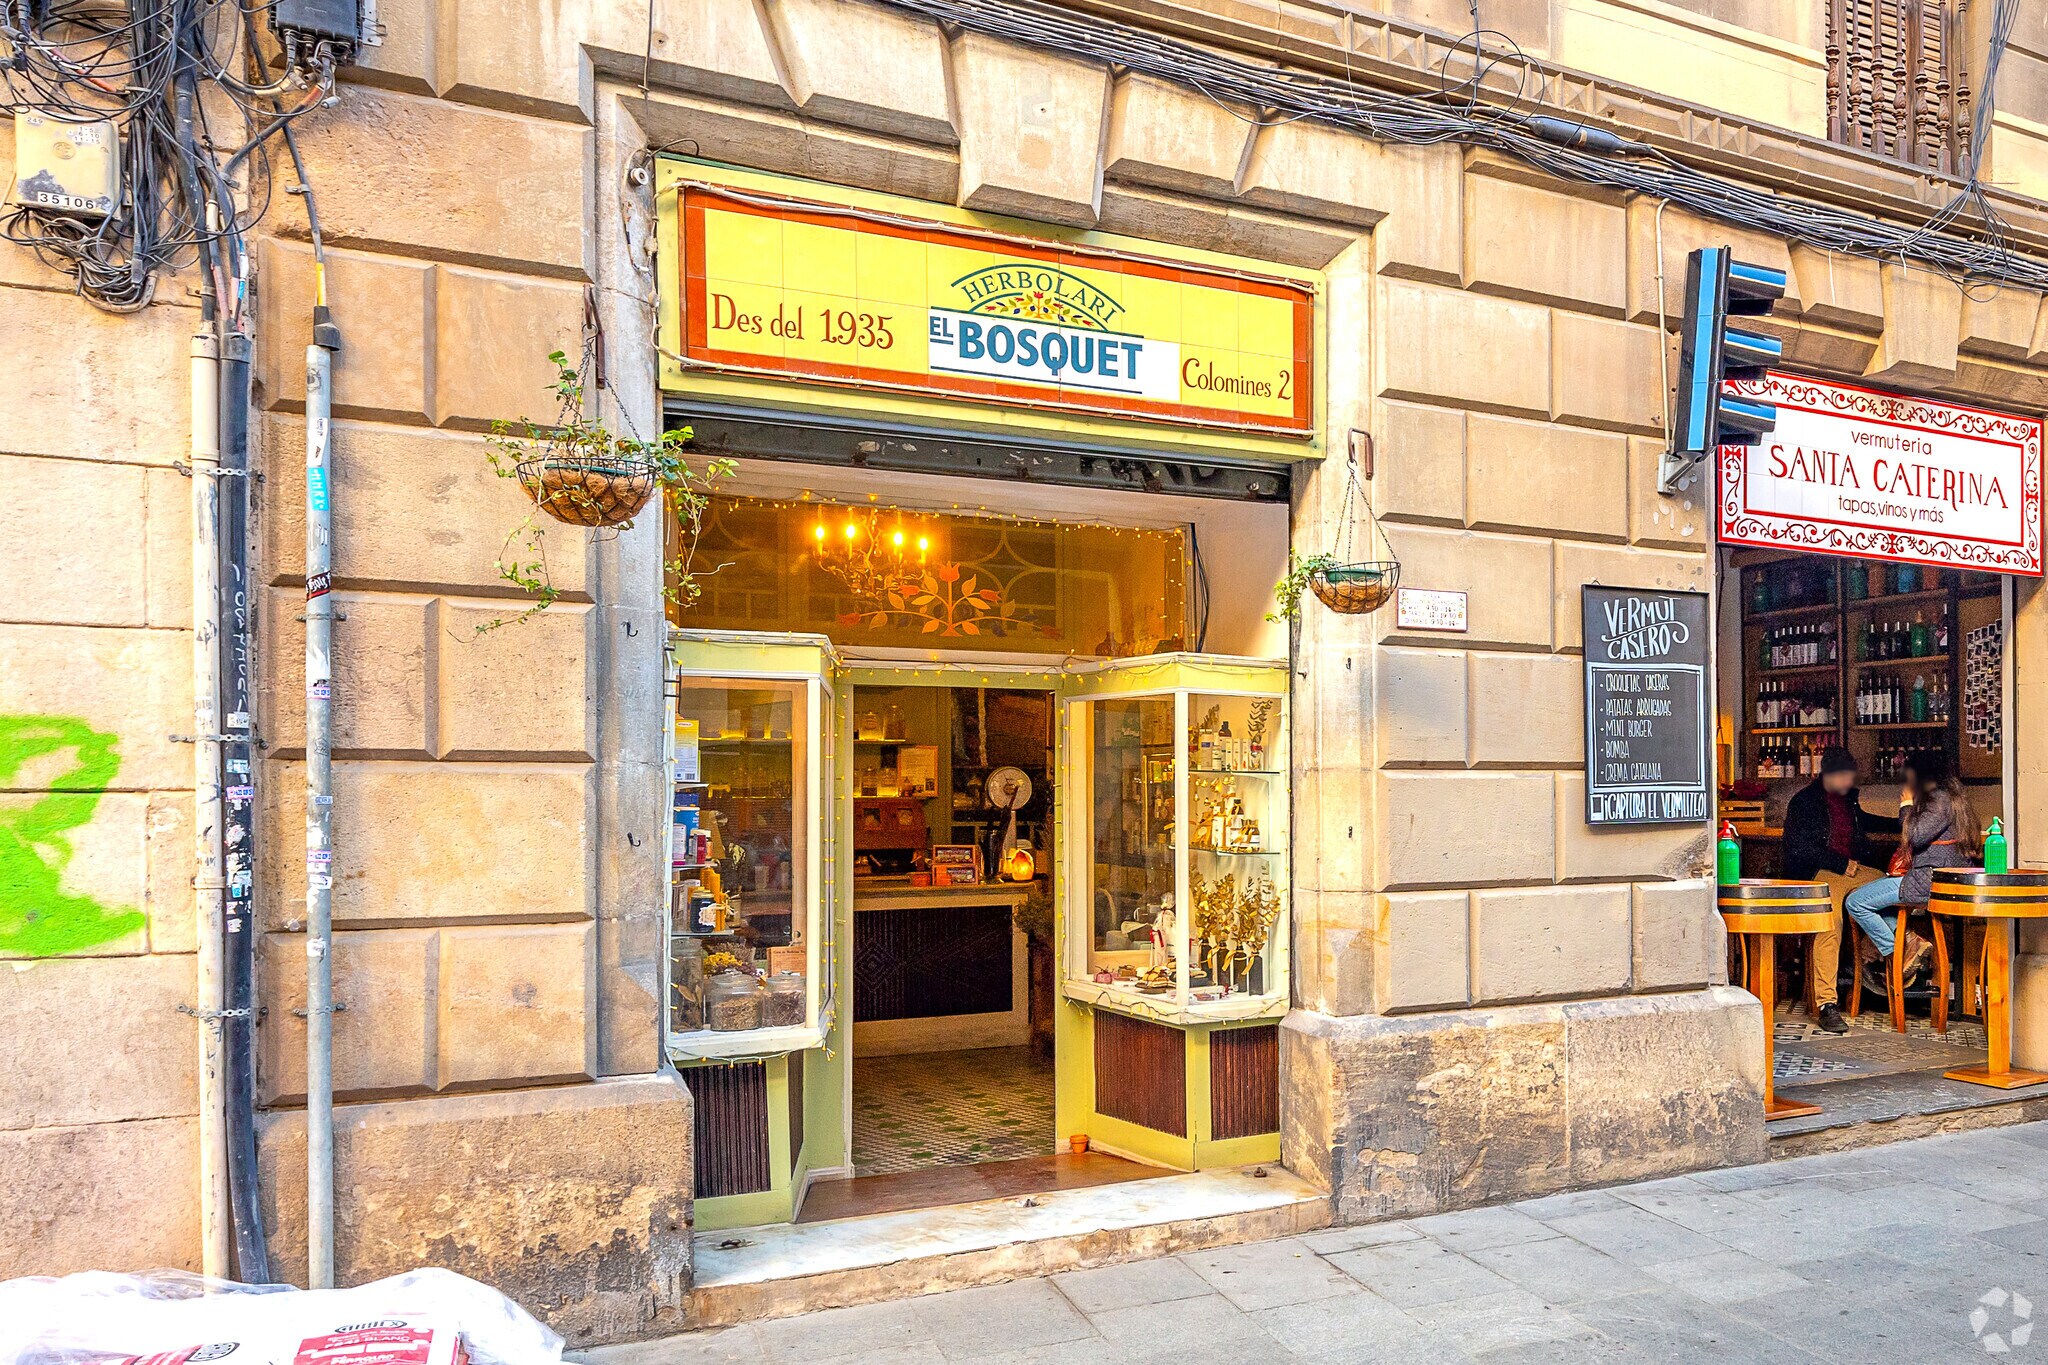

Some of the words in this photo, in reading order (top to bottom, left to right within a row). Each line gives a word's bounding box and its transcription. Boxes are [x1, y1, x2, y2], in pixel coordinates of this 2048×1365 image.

[39, 193, 95, 209] 35106
[961, 270, 1117, 324] HERBOLARI
[710, 293, 763, 335] Des
[770, 303, 805, 340] del
[819, 308, 894, 350] 1935
[930, 315, 954, 338] EL
[958, 319, 1144, 380] BOSQUET
[1182, 358, 1272, 398] Colomines
[1277, 369, 1292, 401] 2
[1768, 444, 1861, 489] SANTA
[1872, 458, 2009, 512] CATERINA
[1909, 507, 1918, 522] y
[1919, 506, 1944, 523] más
[1603, 595, 1681, 637] VERMUT
[1607, 623, 1671, 660] CASERO
[1605, 673, 1641, 692] CROQUETAS
[1645, 673, 1670, 691] CASERAS
[1605, 698, 1633, 716] PATATAS
[1636, 697, 1672, 716] ARRUGADAS
[1605, 719, 1624, 737] MINI
[1627, 719, 1653, 738] BURGER
[1605, 740, 1630, 758] BOMBA
[1604, 763, 1628, 782] CREMA
[1630, 762, 1662, 781] CATALANA
[1648, 792, 1660, 818] EL
[1661, 792, 1707, 819] VERMUTEO!
